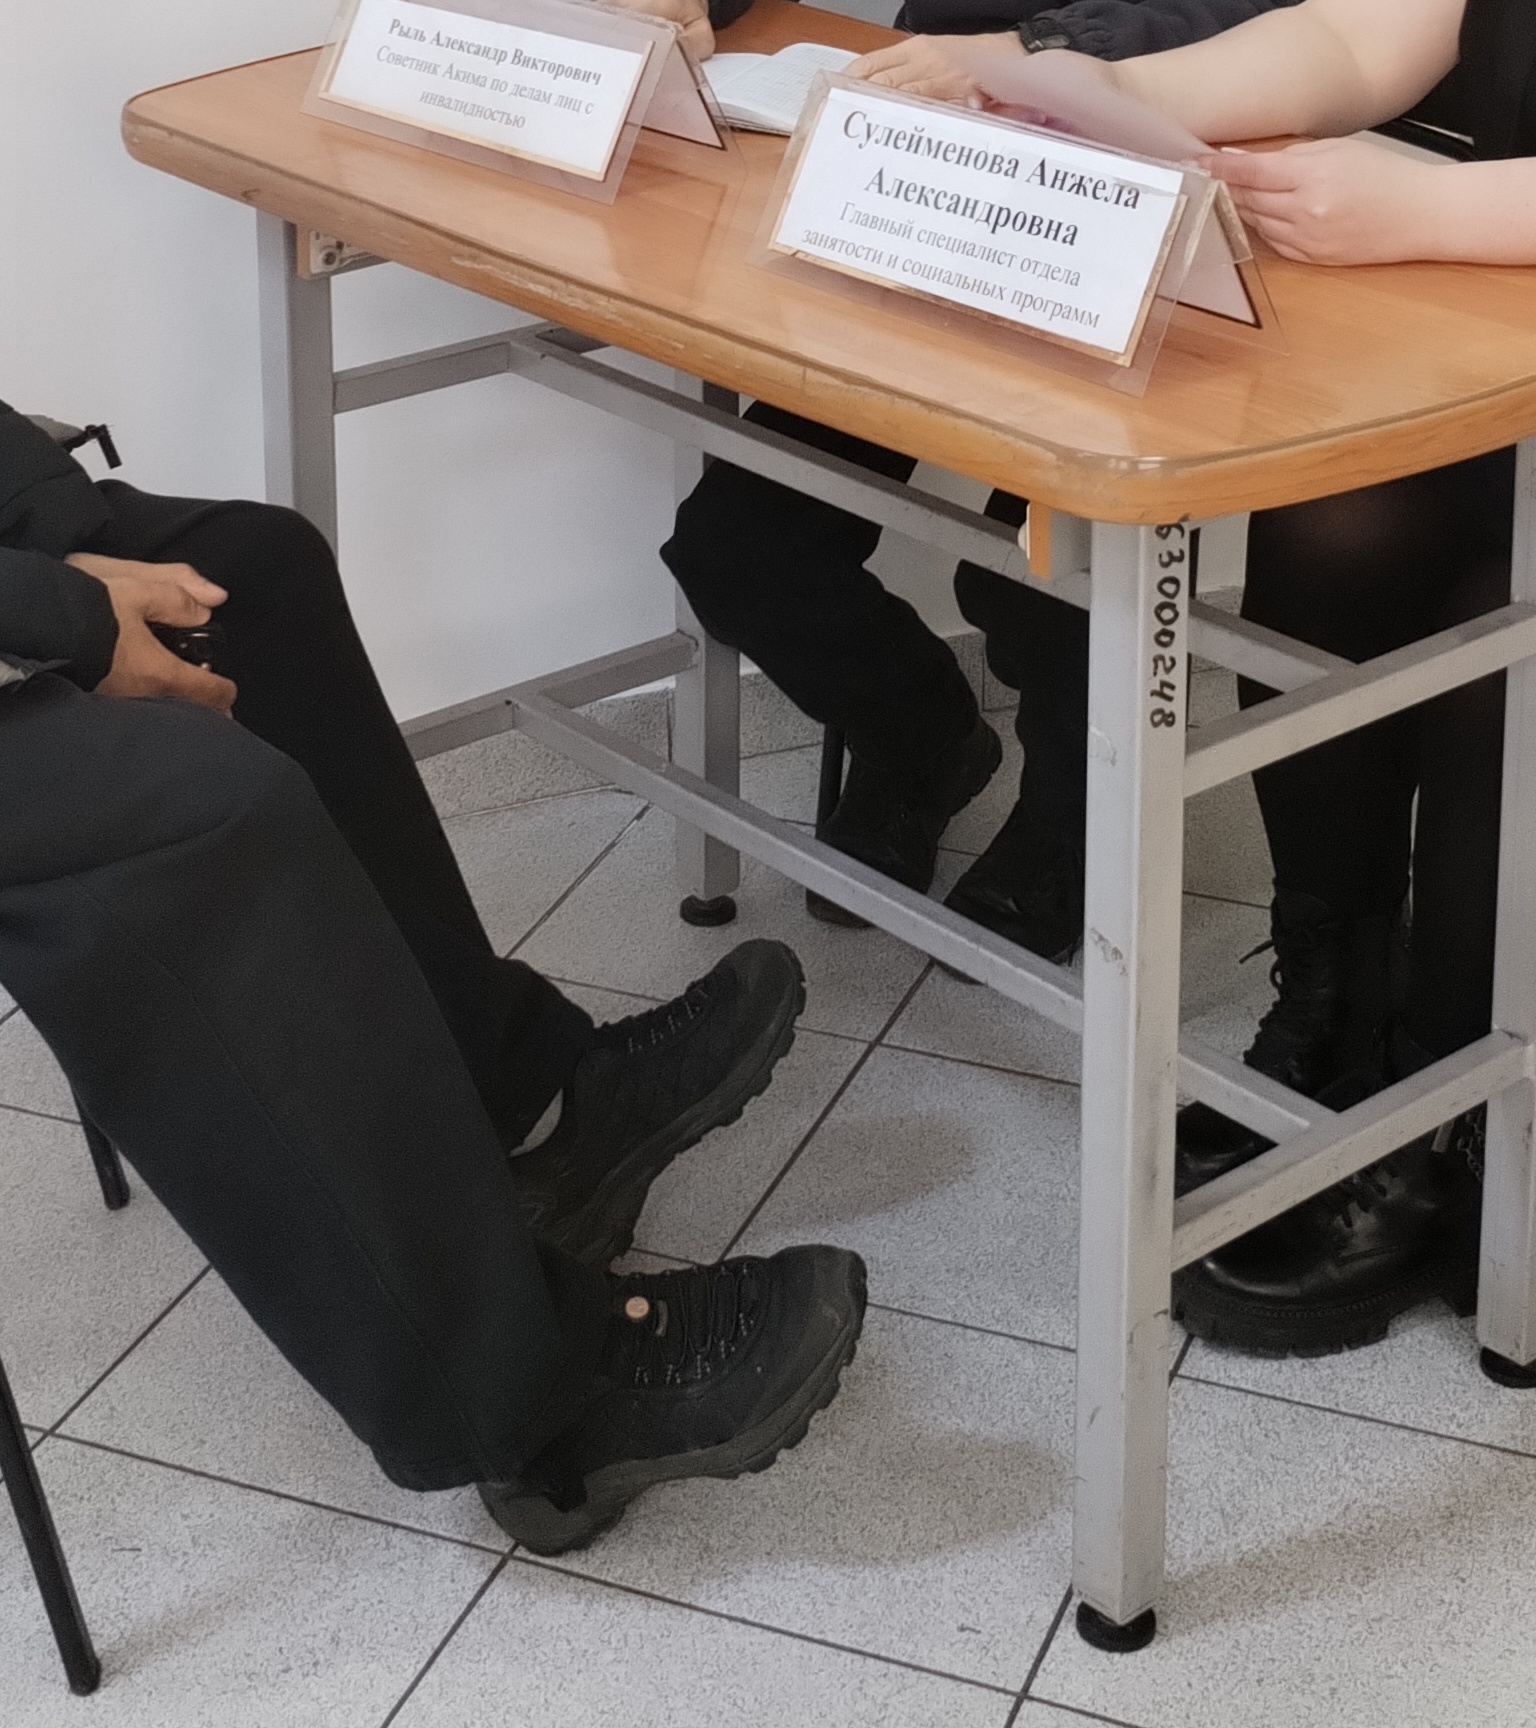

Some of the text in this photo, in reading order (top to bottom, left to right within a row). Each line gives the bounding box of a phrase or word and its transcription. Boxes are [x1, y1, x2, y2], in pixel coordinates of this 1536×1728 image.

[375, 44, 595, 116] Советник Акима по делам лиц с
[387, 17, 602, 87] Рыль Александр Викторович
[419, 90, 526, 130] инвалидностью
[842, 109, 1141, 211] Сулейменова Анжела
[838, 201, 1081, 289] Главный специалист отдела
[863, 165, 1080, 248] Александровна
[801, 227, 1101, 330] занятости и социальных программ
